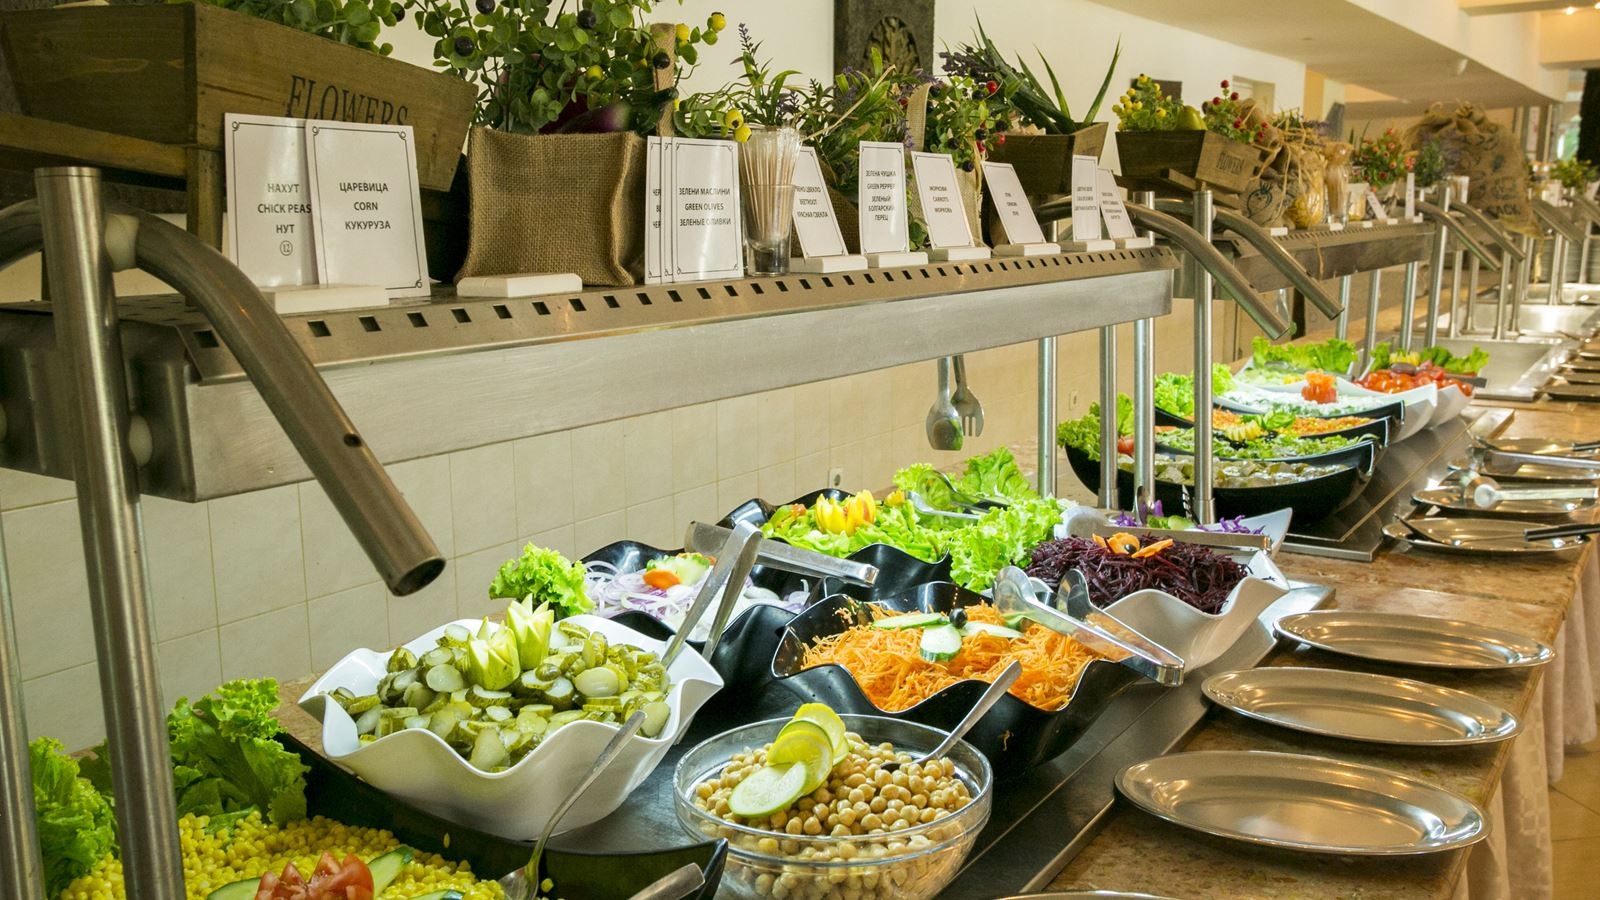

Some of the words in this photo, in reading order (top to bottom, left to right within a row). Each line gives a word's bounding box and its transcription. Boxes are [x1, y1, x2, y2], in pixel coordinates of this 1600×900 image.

[285, 74, 409, 126] FLOWERS
[267, 183, 300, 193] НАХУТ
[340, 182, 389, 193] ЦАРЕВИЦА
[679, 187, 700, 196] ЗЕЛЕНИ
[257, 203, 286, 214] CHICK
[288, 204, 311, 214] PEAS
[353, 201, 379, 212] CORN
[684, 203, 703, 211] GREEN
[703, 203, 724, 211] OLIVES
[344, 220, 391, 231] КУКУРУЗА
[679, 218, 705, 226] ЗЕЛЕНЫЕ
[275, 224, 295, 234] НУТ
